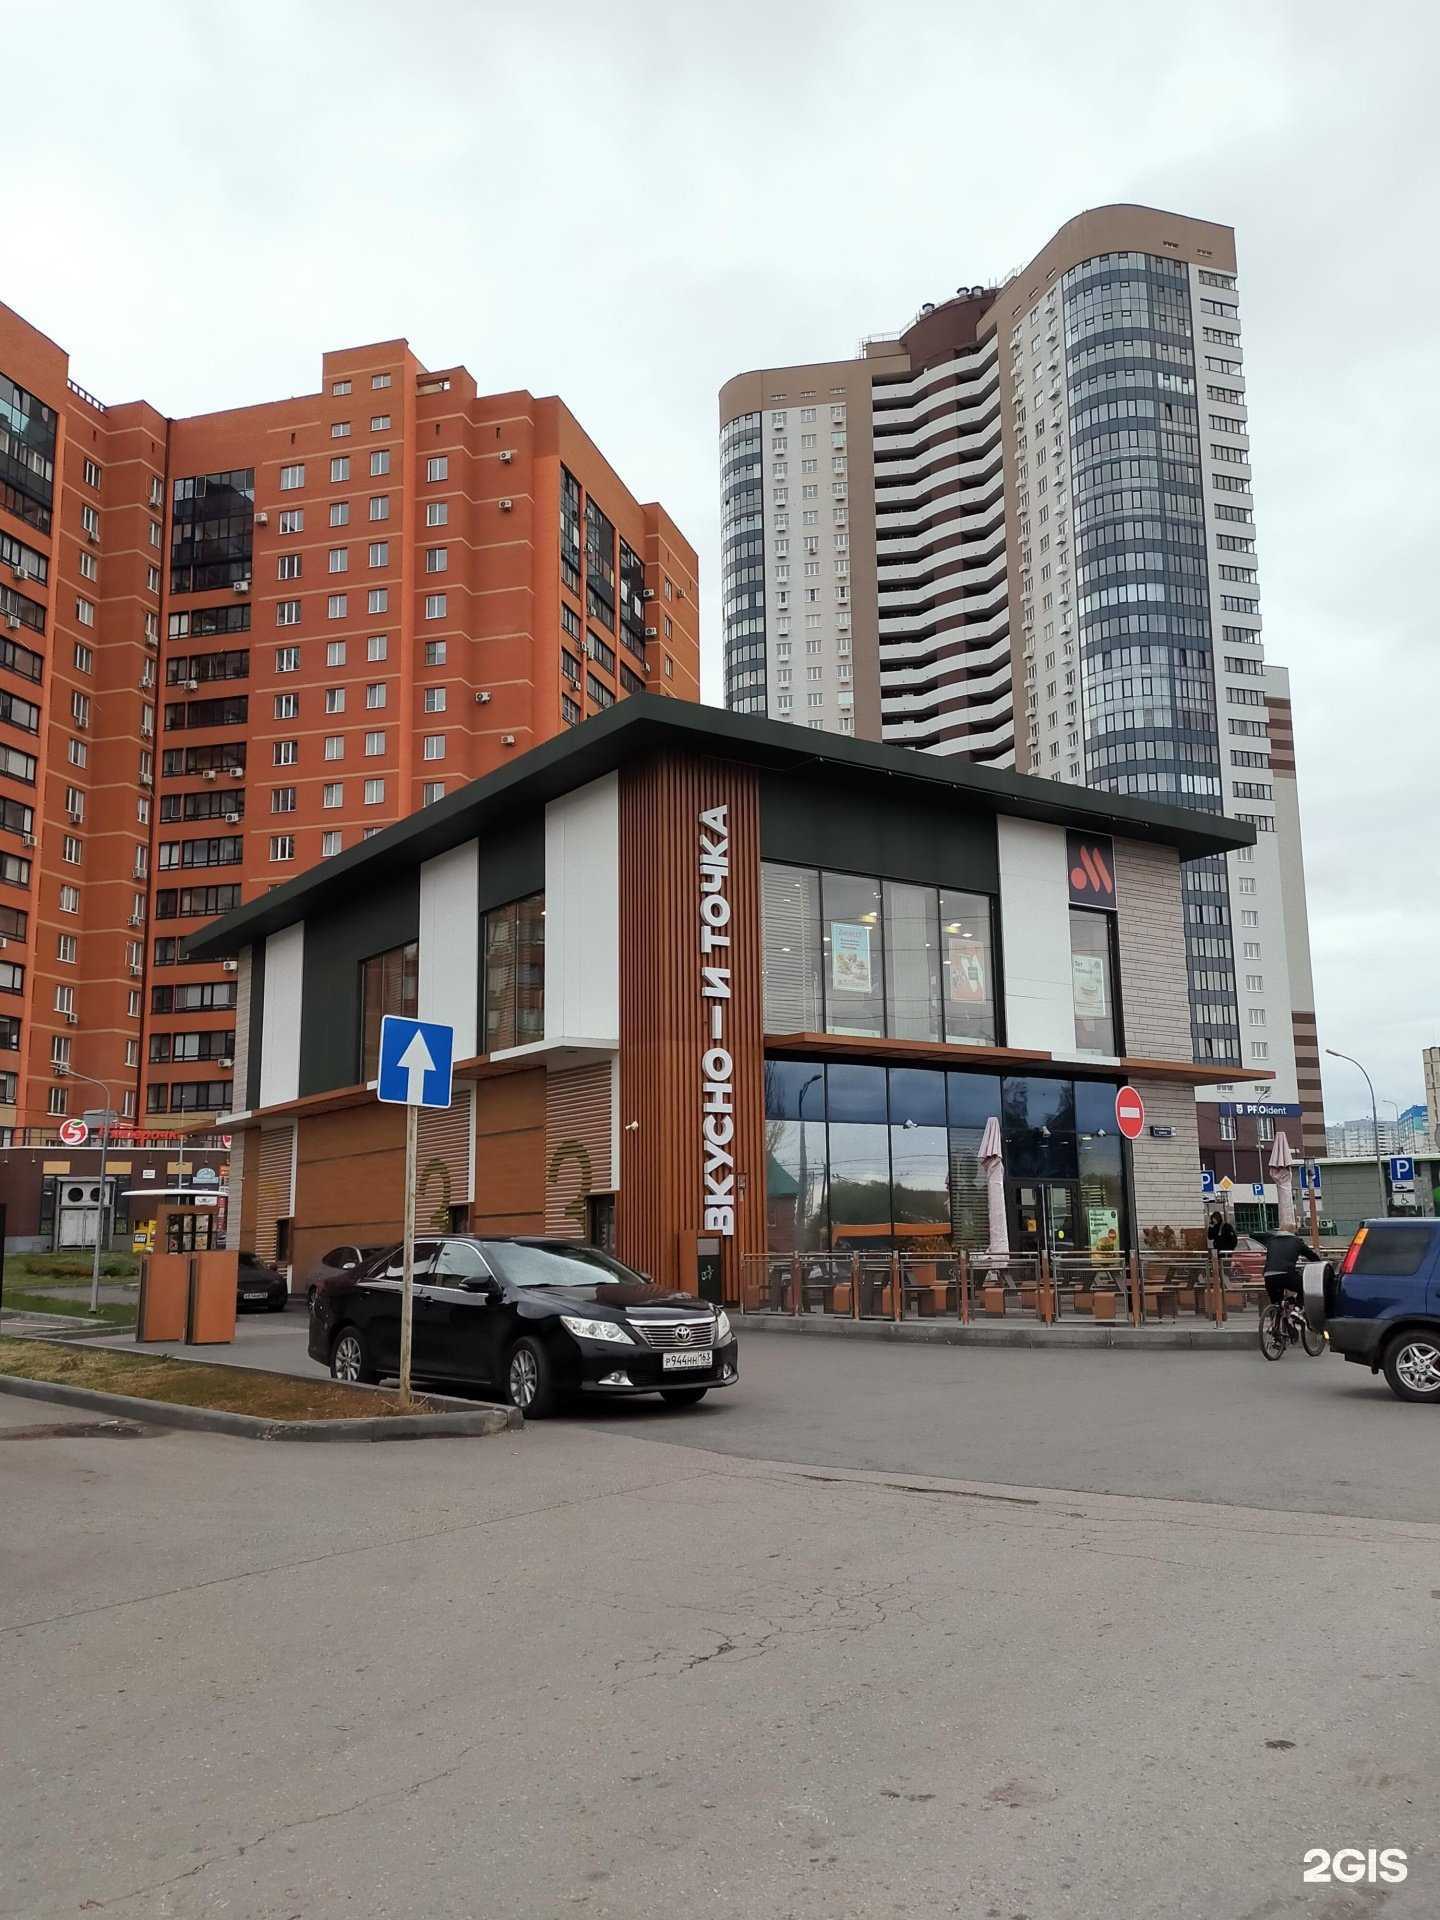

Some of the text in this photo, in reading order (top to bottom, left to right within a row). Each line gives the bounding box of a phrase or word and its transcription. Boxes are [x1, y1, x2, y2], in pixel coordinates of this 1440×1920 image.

[699, 804, 731, 953] ТОЧКА
[702, 966, 731, 999] И
[702, 1047, 735, 1236] ВКУСНО
[1201, 1173, 1211, 1190] P
[1396, 1159, 1410, 1179] P
[1254, 1184, 1262, 1195] P
